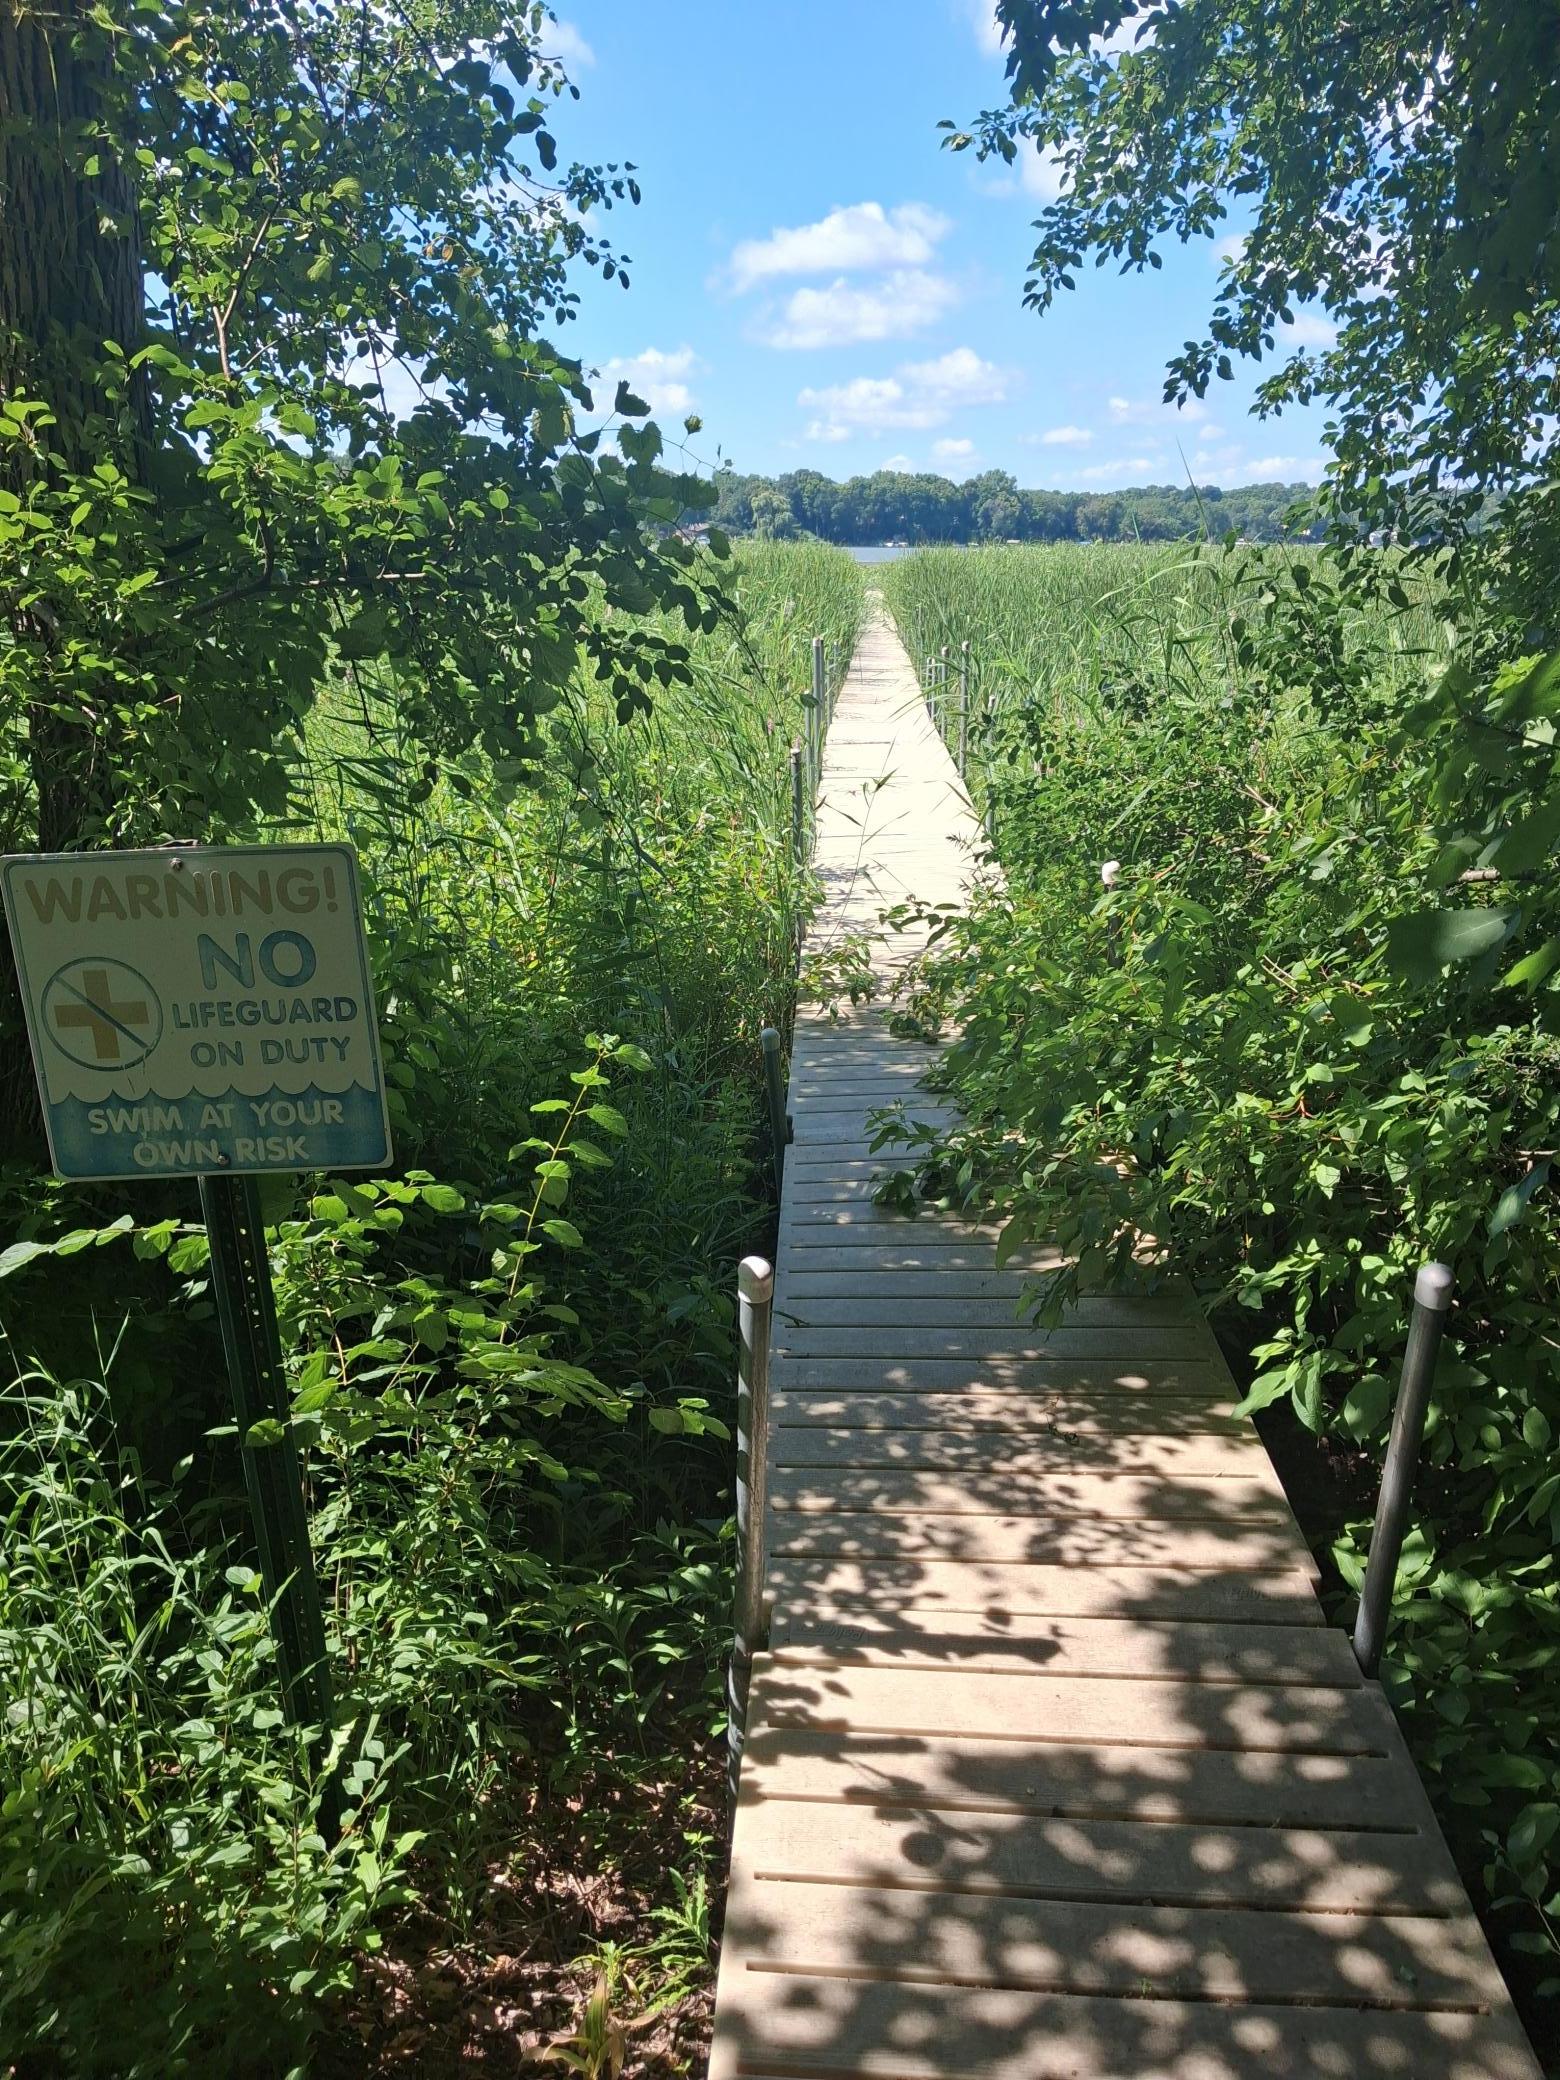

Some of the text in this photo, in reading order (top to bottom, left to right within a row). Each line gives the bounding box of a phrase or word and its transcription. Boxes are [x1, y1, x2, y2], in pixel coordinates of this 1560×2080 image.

[24, 866, 339, 924] WARNING!
[196, 930, 317, 990] NO
[171, 996, 358, 1028] LIFEGUARD
[190, 1036, 351, 1067] ON DUTY
[87, 1099, 345, 1135] SWIM AT YOUR
[133, 1135, 311, 1167] OWN RISK
